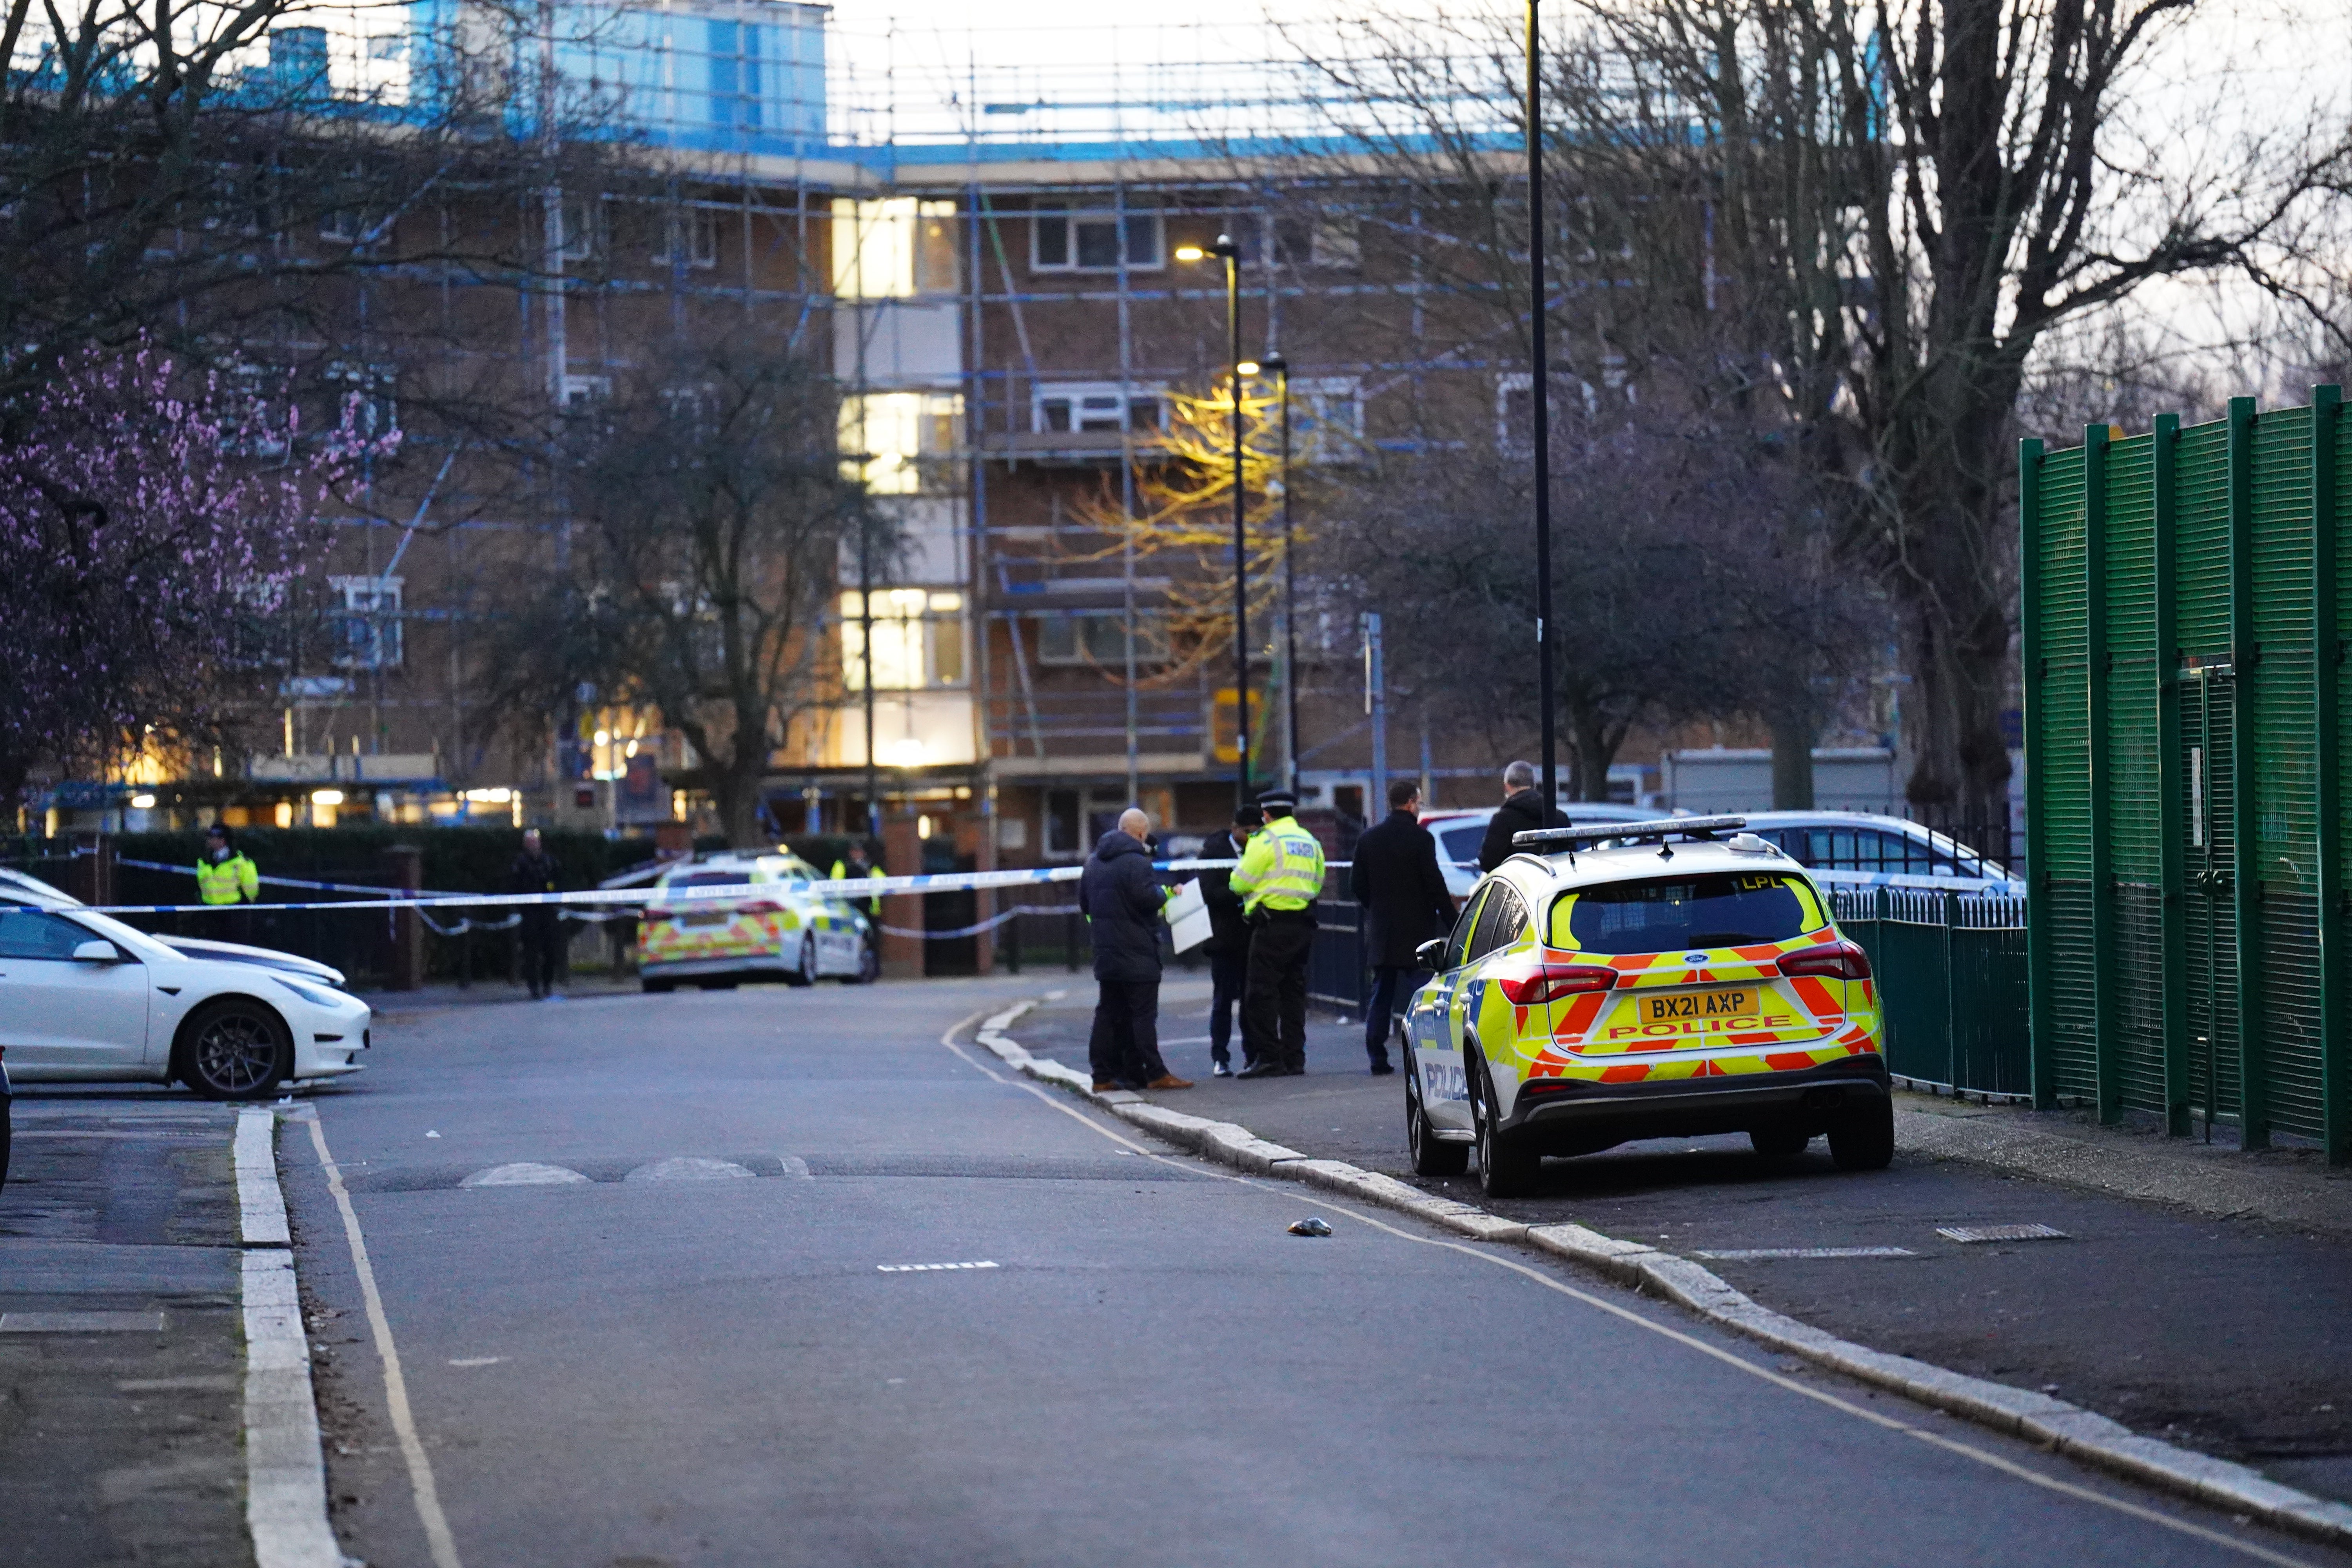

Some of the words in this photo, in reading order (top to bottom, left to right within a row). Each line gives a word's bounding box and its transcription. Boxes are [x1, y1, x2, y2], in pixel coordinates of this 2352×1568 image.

[1741, 876, 1784, 889] LPL
[1651, 996, 1699, 1018] BX21
[1706, 993, 1744, 1014] AXP
[1609, 1015, 1793, 1039] POLICE
